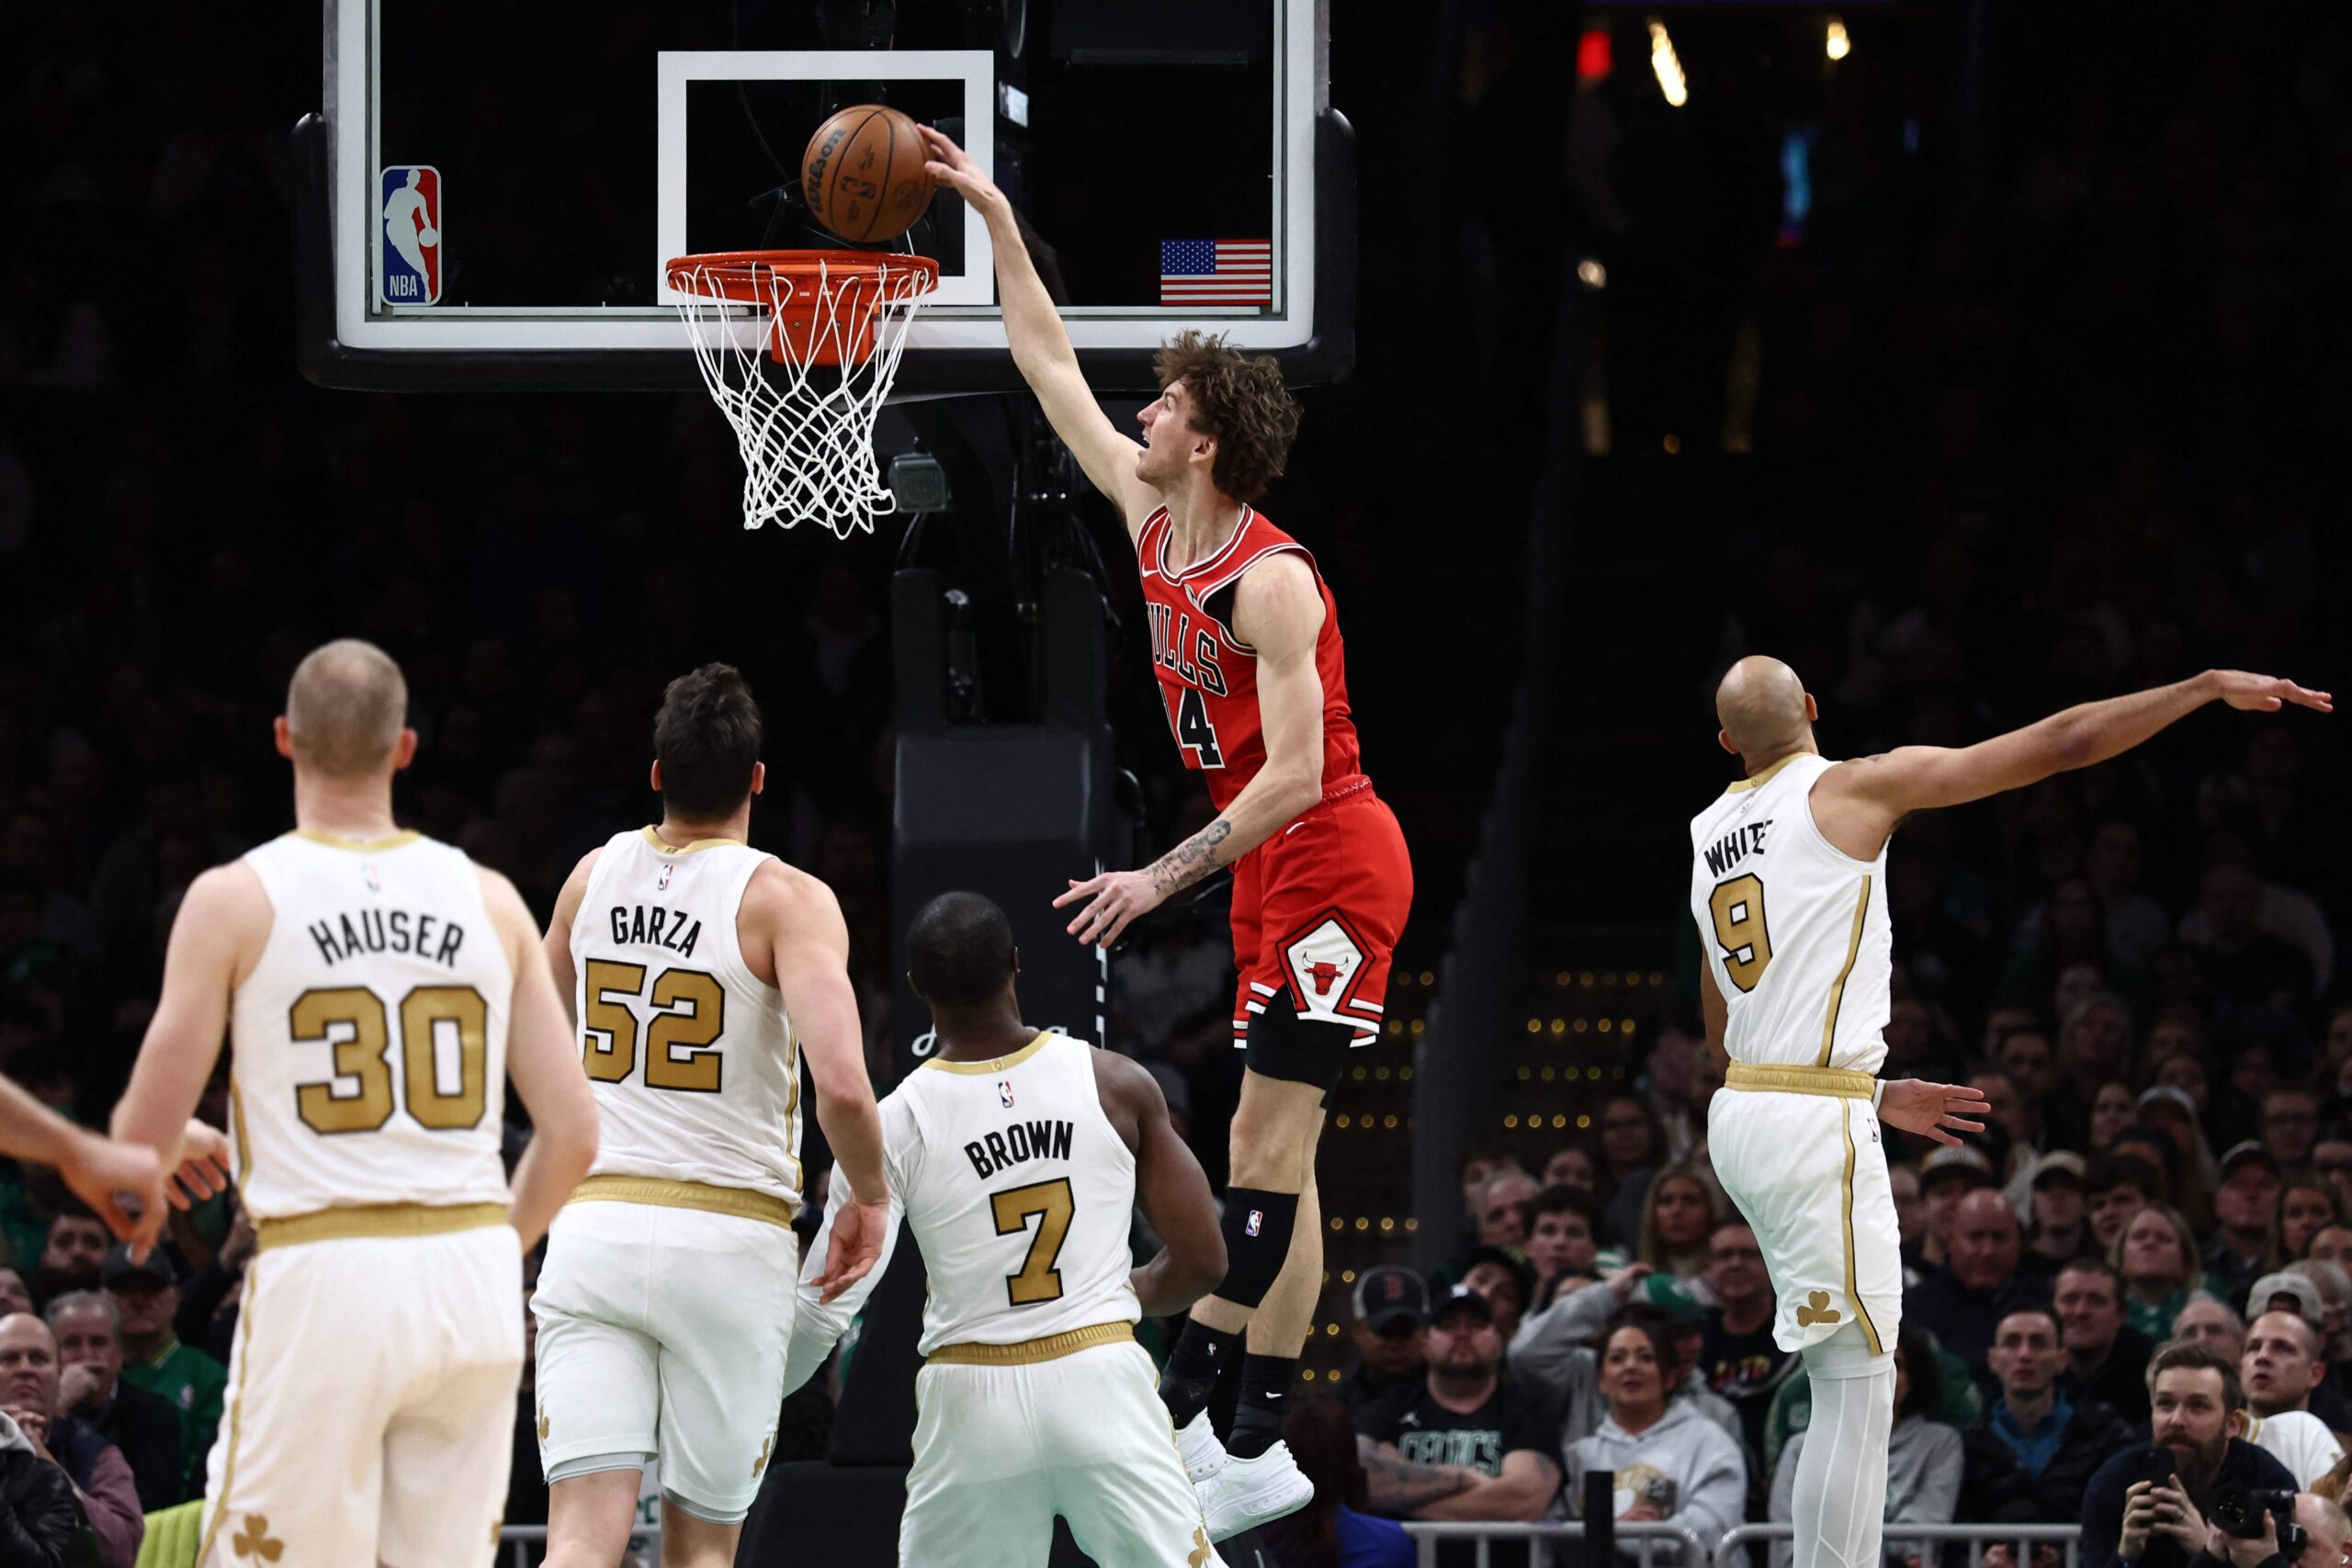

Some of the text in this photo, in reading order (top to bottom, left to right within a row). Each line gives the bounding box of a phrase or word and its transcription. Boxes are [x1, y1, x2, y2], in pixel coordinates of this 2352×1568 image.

[390, 275, 418, 297] NBA
[1147, 602, 1228, 697] ULLS
[1703, 818, 1774, 878] WHITE
[309, 908, 465, 968] HAUSER
[610, 905, 702, 960] GARZA
[1707, 871, 1773, 994] 9
[288, 984, 488, 1136] 30
[582, 956, 726, 1094] 52
[964, 1119, 1074, 1180] BROWN
[989, 1176, 1076, 1306] 7
